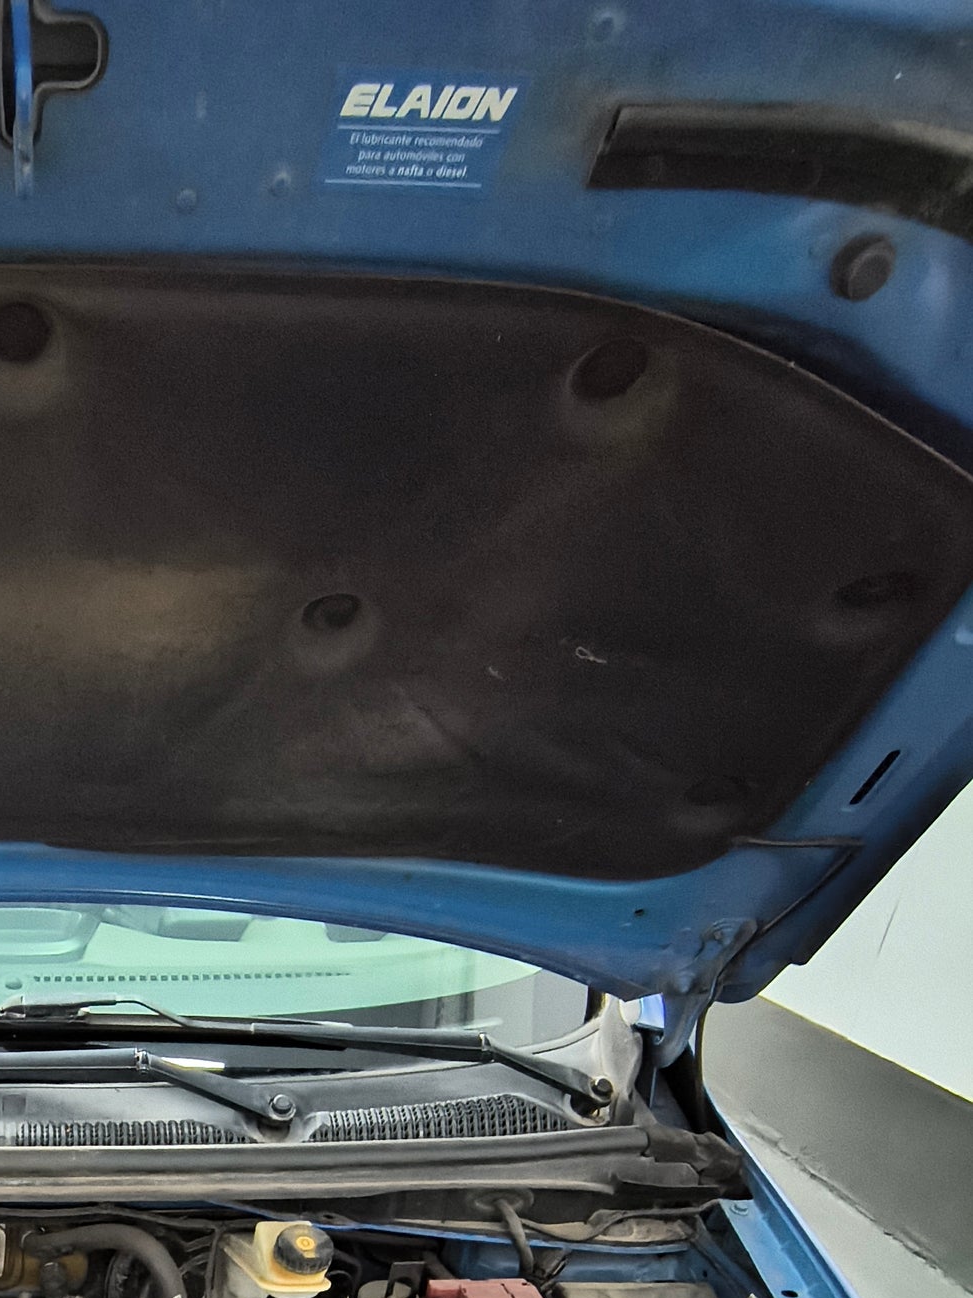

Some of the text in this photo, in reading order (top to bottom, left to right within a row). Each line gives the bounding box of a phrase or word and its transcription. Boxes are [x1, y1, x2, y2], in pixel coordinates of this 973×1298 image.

[339, 83, 519, 122] ELAION
[360, 131, 412, 146] lubricante
[414, 135, 484, 149] recomendado
[357, 150, 381, 162] para
[446, 153, 465, 163] con
[346, 164, 385, 177] motores
[397, 164, 424, 178] nafta
